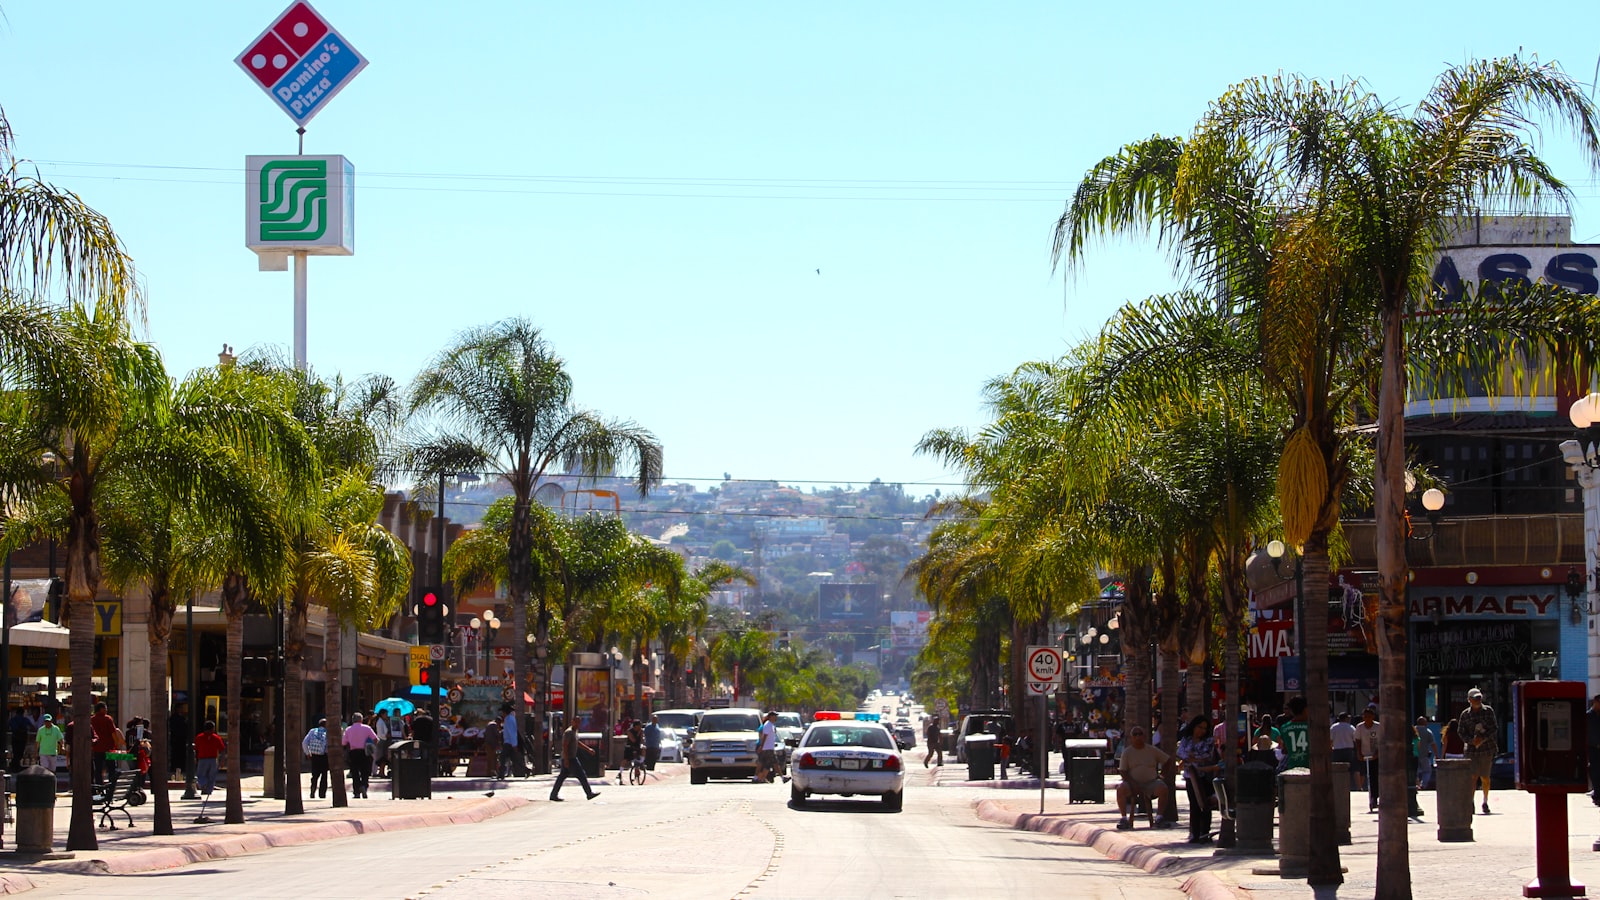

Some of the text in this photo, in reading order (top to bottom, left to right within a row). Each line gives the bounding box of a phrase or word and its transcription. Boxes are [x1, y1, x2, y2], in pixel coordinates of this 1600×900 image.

[276, 43, 340, 102] Domino's
[290, 78, 332, 115] Pizza
[96, 605, 118, 632] Y
[1035, 654, 1053, 665] 40
[1036, 666, 1054, 674] km/h
[1288, 730, 1309, 753] 14
